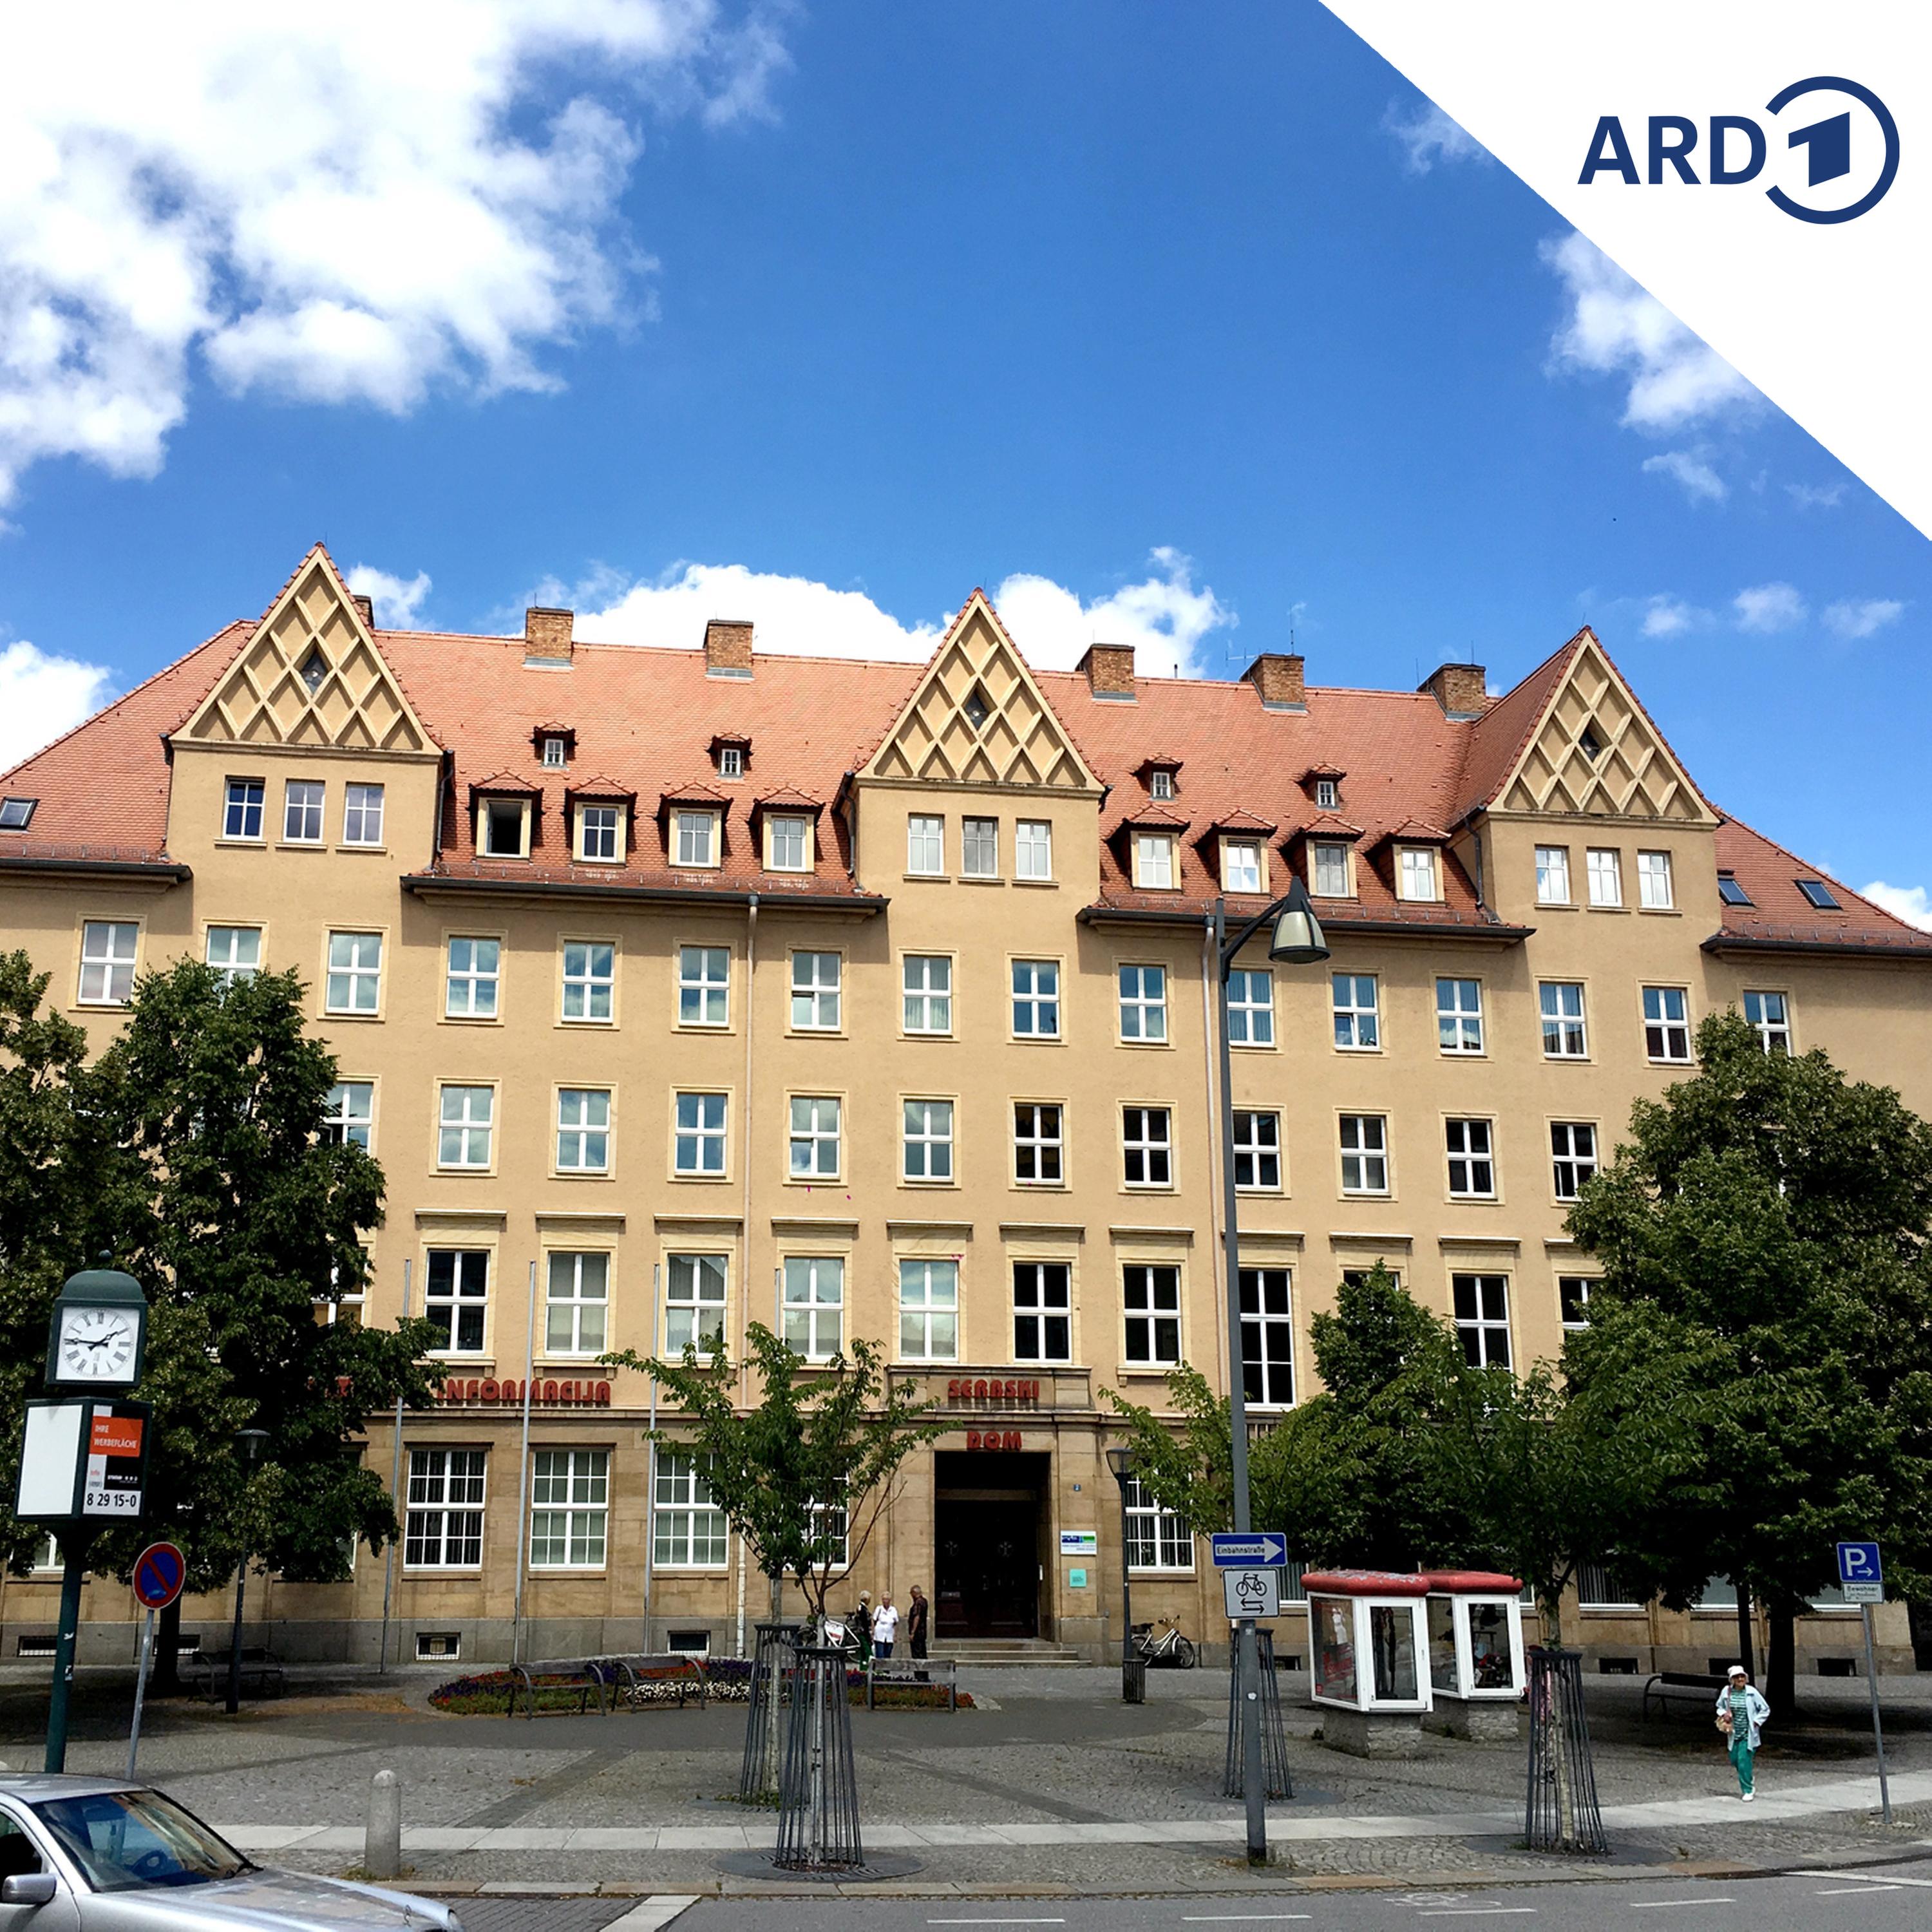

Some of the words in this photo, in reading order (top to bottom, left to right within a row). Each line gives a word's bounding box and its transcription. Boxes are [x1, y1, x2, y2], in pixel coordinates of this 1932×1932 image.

[948, 1379, 1039, 1399] SERBSKI
[95, 1425, 109, 1433] IHRE
[93, 1437, 137, 1448] WERBEFLÄCHE
[967, 1430, 1022, 1450] DOM
[87, 1493, 93, 1506] 8
[97, 1493, 110, 1507] 29
[113, 1493, 137, 1508] 15-0
[1844, 1548, 1867, 1577] P
